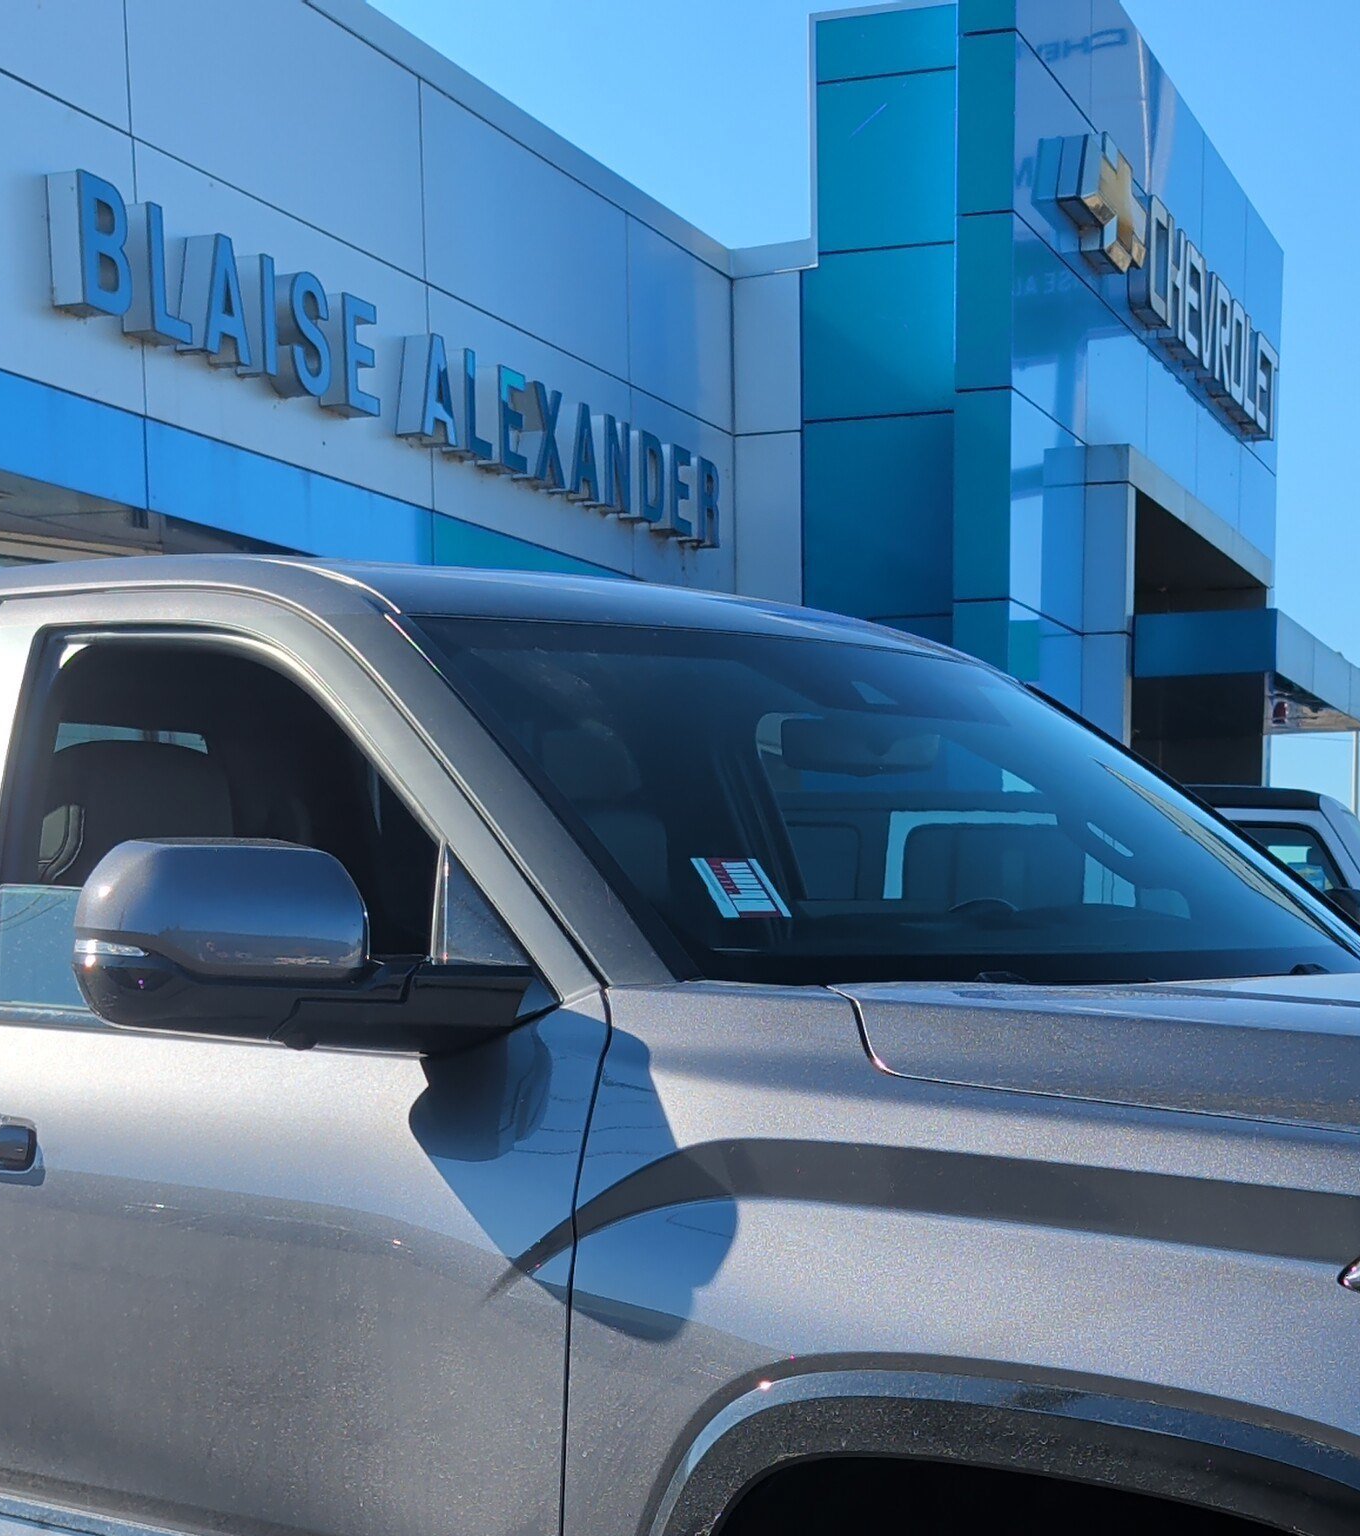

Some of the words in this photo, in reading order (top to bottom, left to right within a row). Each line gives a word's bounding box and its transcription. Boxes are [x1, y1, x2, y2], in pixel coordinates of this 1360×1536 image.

[70, 168, 380, 419] BLAISE
[412, 332, 721, 549] ALEXANDER
[1144, 194, 1281, 441] CHEVROLET
